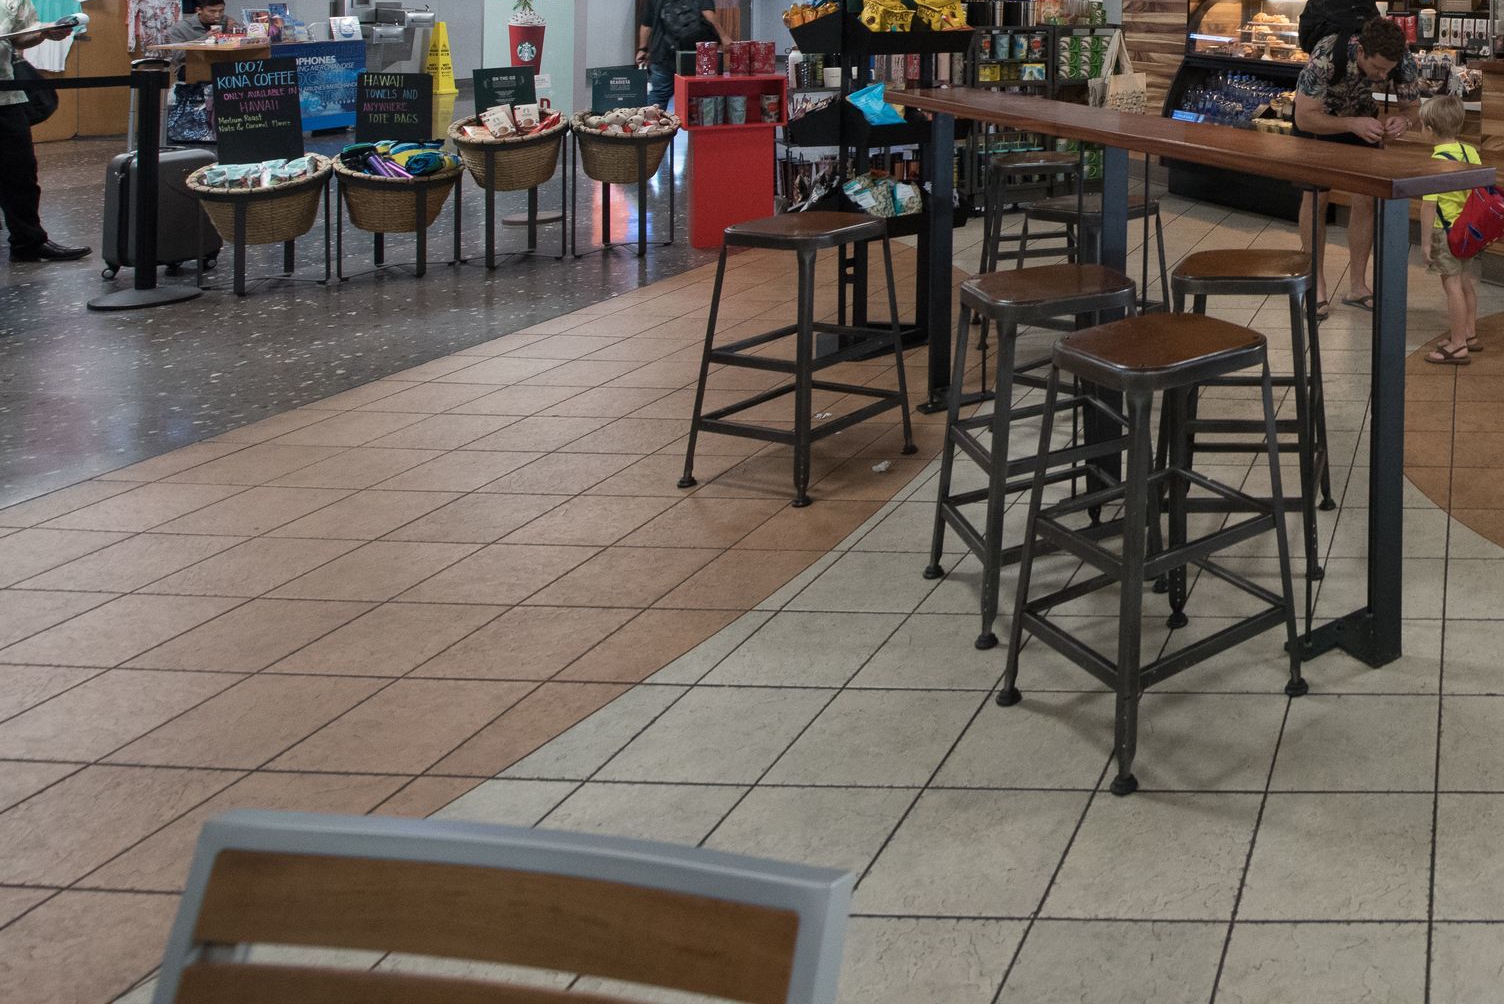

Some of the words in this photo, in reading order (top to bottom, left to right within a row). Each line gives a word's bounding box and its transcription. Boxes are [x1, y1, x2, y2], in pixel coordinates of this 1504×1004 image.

[235, 60, 264, 74] 100%
[217, 74, 251, 90] KONA
[254, 70, 296, 86] COFFEE
[364, 74, 404, 88] HAWAII
[223, 91, 244, 101] ONLY
[248, 87, 285, 98] AVAILABLE
[288, 86, 297, 95] IN
[365, 88, 398, 99] TOWELS
[402, 88, 418, 100] AND
[240, 99, 279, 113] HAWAII
[363, 101, 408, 112] ANYWHERE
[368, 113, 389, 124] TOTE
[394, 113, 419, 124] BAGS
